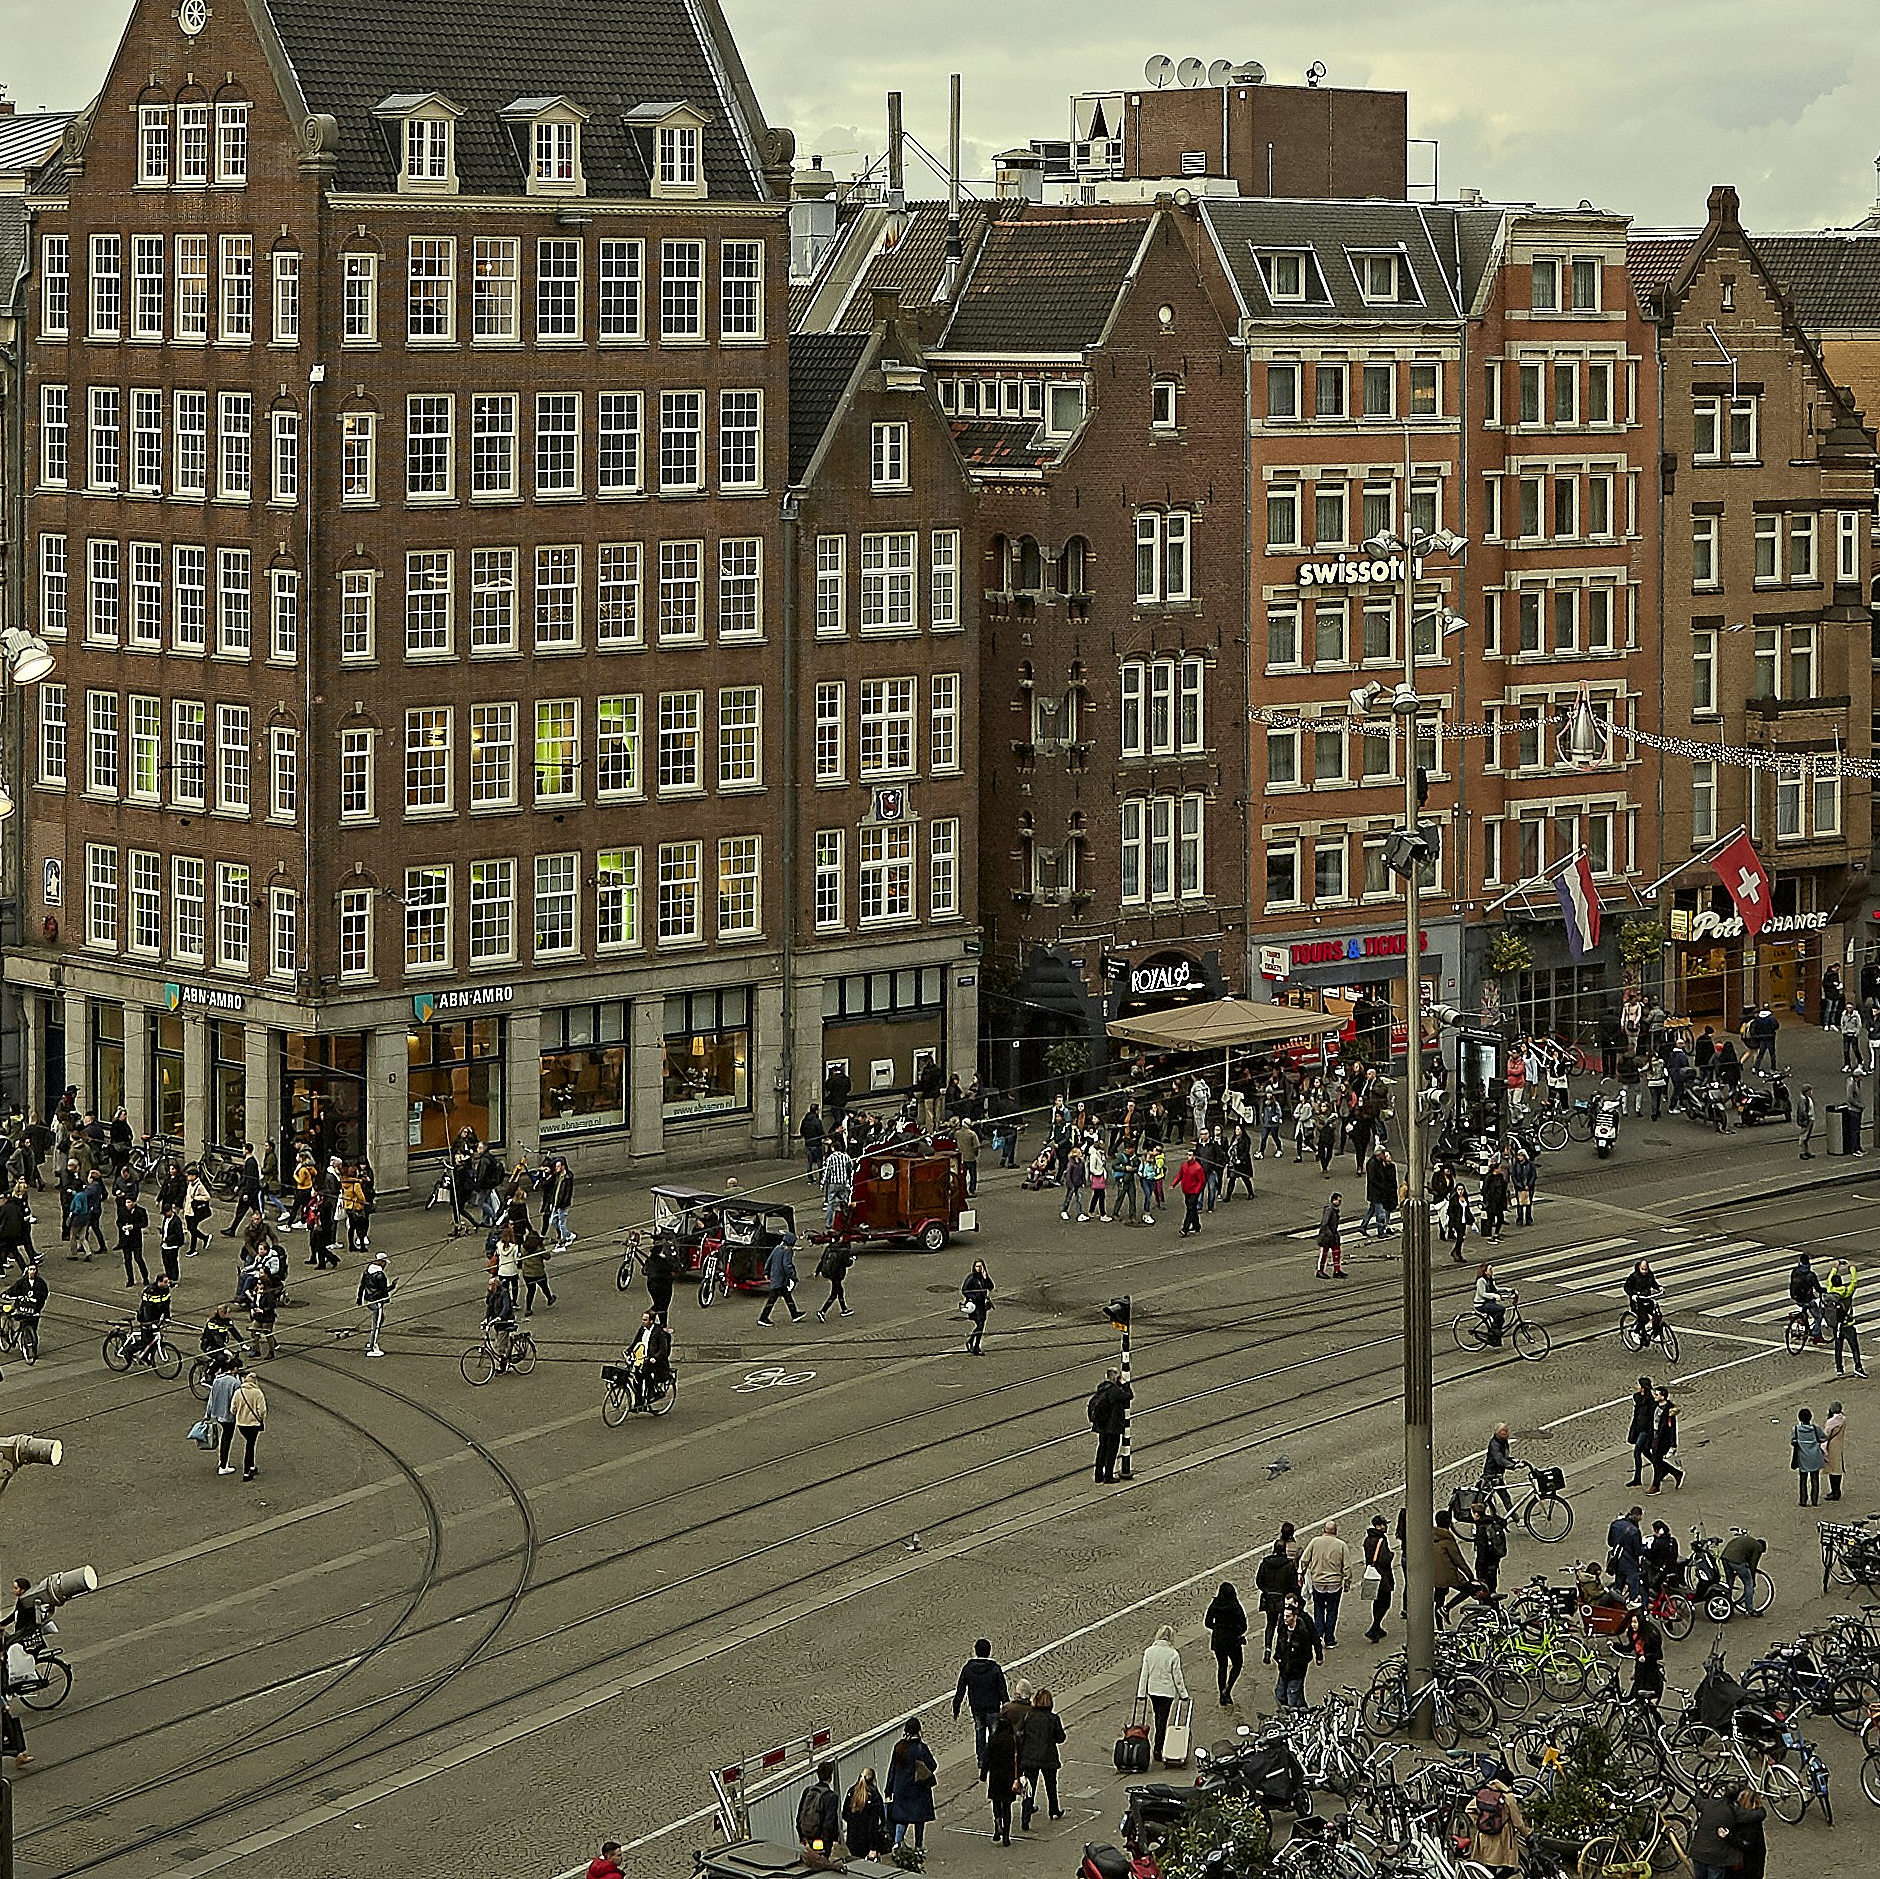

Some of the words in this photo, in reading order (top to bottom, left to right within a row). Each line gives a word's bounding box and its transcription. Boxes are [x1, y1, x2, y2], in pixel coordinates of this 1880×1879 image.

[1693, 911, 1743, 941] Pott
[1290, 941, 1343, 965] TOURS
[1348, 939, 1360, 959] &
[1365, 931, 1428, 957] TICKES
